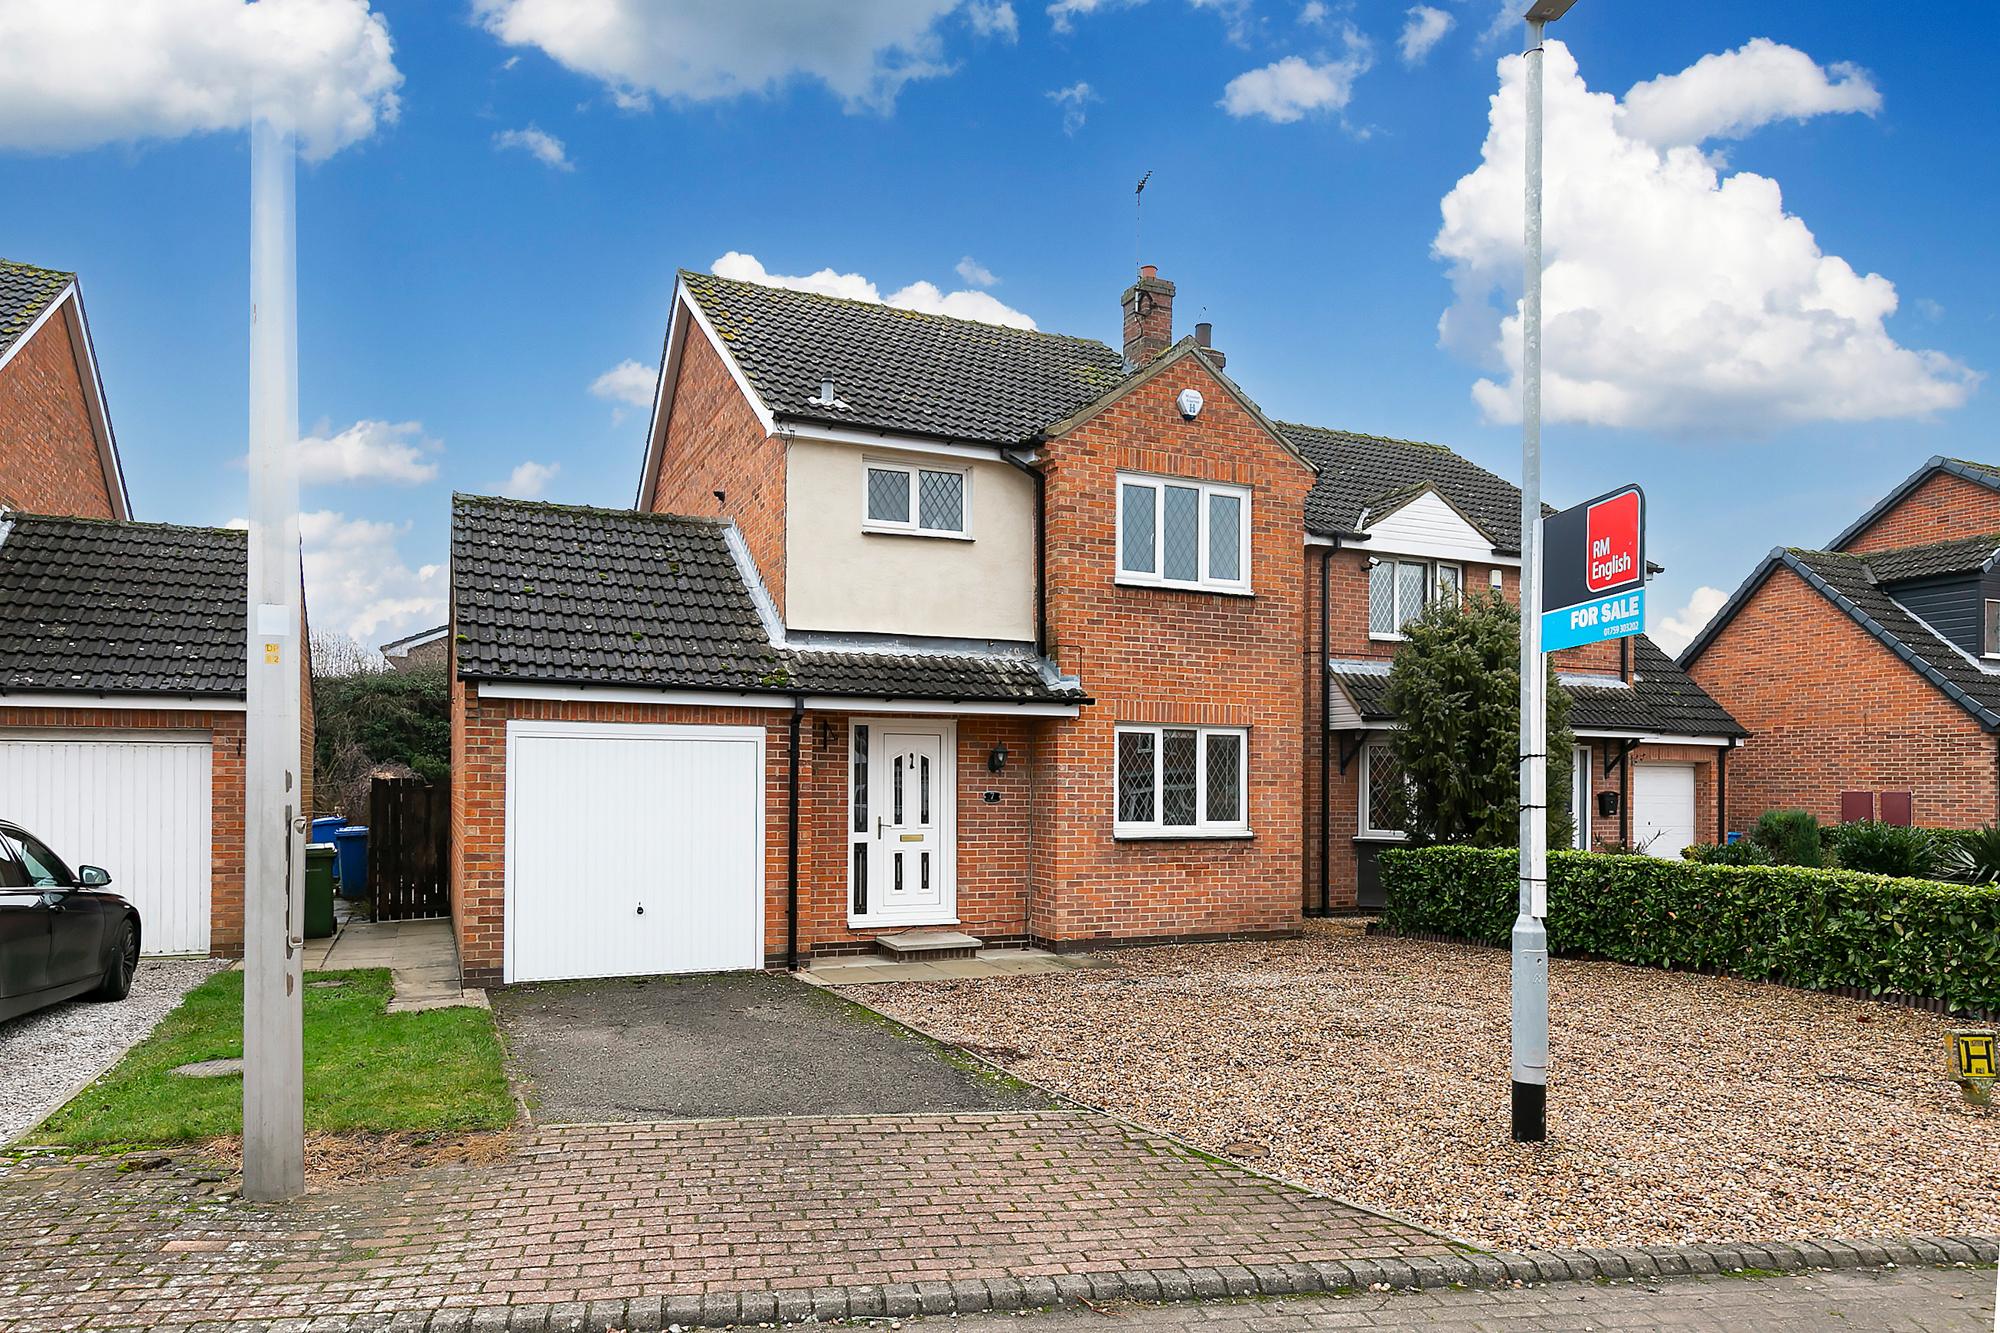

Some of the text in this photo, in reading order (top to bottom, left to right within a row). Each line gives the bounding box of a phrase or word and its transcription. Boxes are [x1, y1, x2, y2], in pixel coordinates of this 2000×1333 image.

[1593, 537, 1610, 559] RM
[1592, 552, 1631, 581] English
[1570, 606, 1599, 630] FOR
[1601, 595, 1640, 623] SALE
[1963, 1040, 1994, 1074] H
